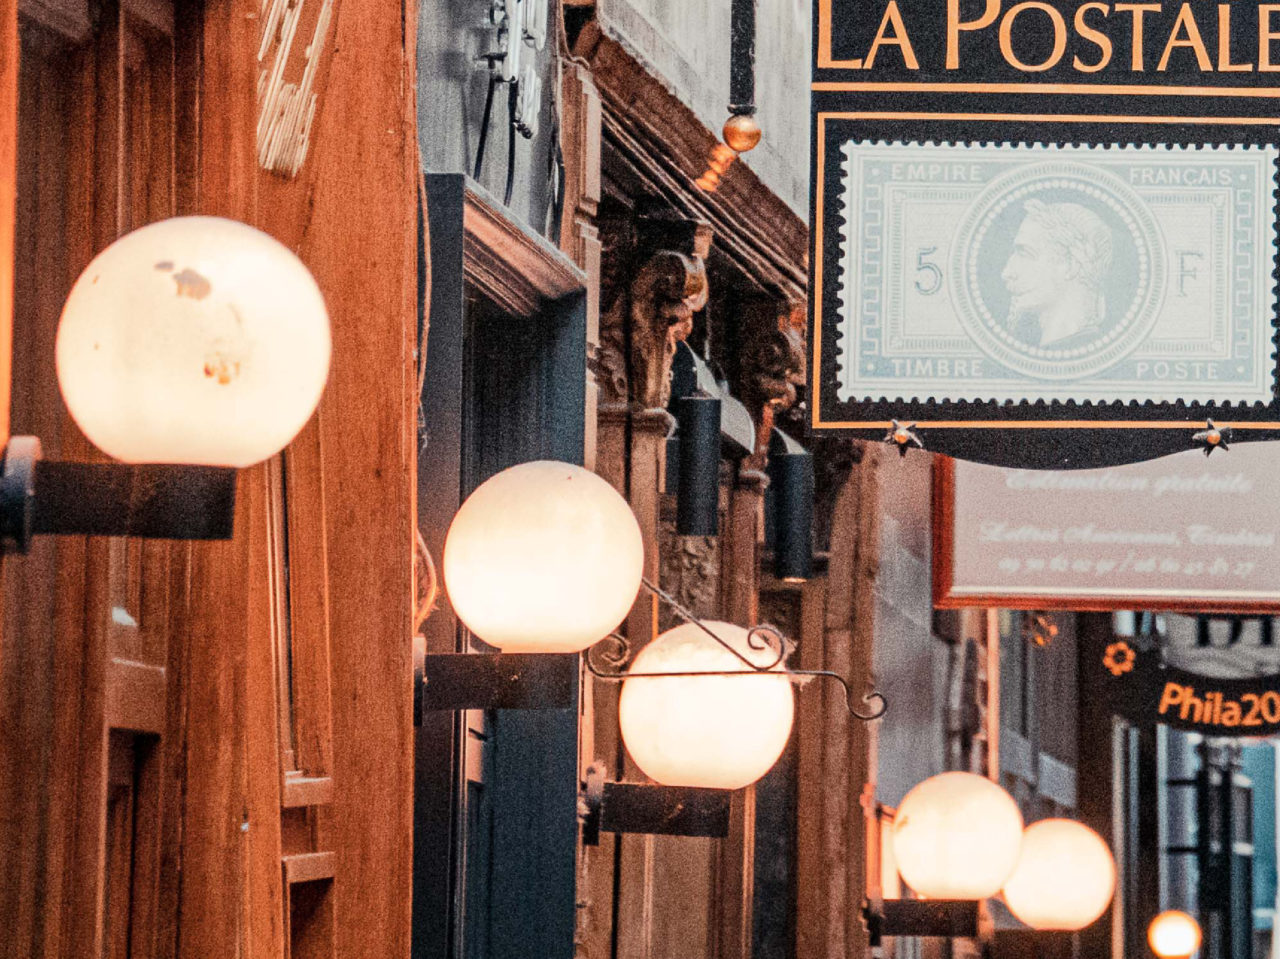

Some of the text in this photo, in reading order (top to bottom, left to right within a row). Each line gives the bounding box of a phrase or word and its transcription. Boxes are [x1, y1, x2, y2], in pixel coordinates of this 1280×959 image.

[891, 164, 1233, 187] EMPIRE FRANÇAIS
[914, 246, 943, 297] 5
[1174, 249, 1203, 298] F
[891, 358, 1220, 381] TIMBRE POSTE
